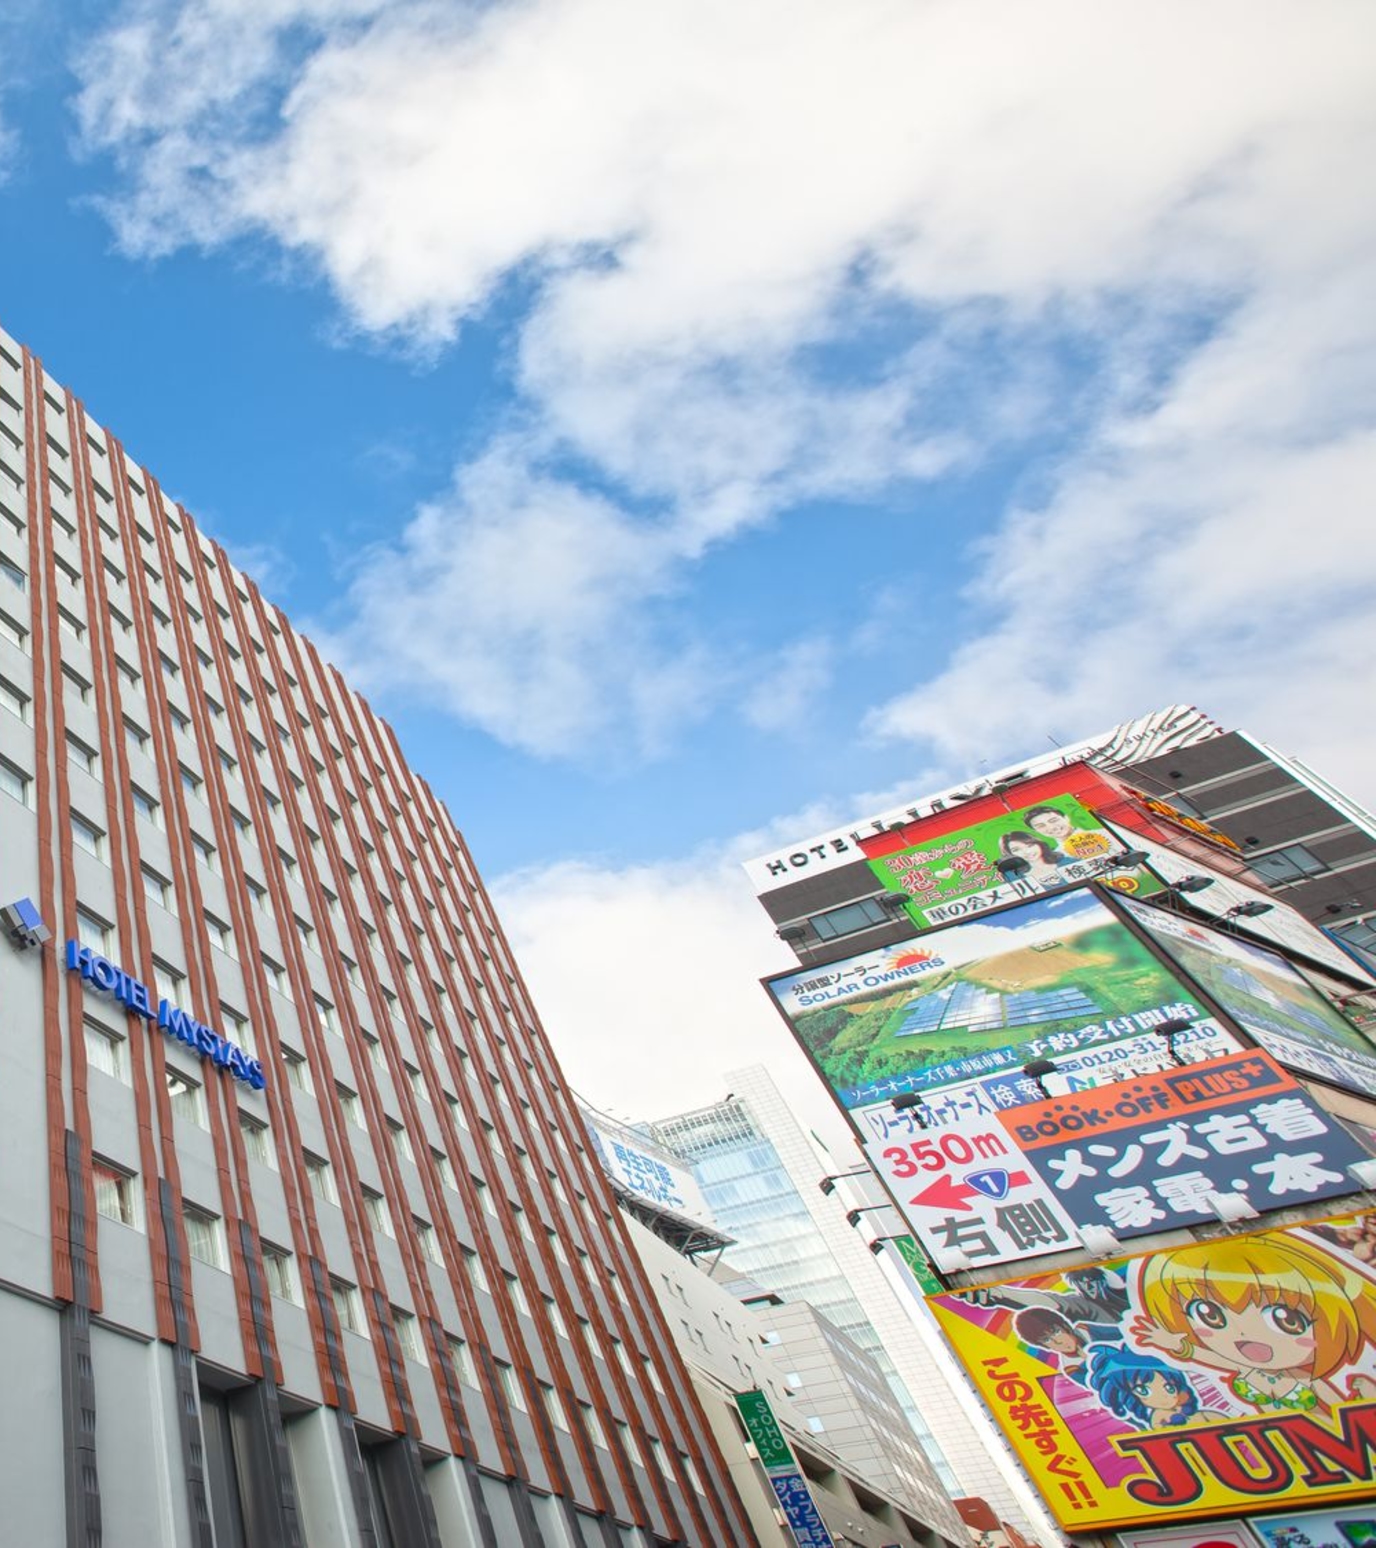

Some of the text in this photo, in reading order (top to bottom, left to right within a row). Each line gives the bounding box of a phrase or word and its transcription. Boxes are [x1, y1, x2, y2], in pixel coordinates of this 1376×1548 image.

[798, 957, 946, 1007] SOLAR OWNERS
[66, 939, 267, 1091] HOTEL MYSTAYS
[1024, 1001, 1200, 1058] 予約受付開始
[883, 1132, 1008, 1178] 350m
[1047, 1098, 1330, 1190] メンズ古着
[979, 1174, 1000, 1194] 1
[1094, 1152, 1346, 1227] 家電・本
[929, 1198, 1069, 1258] 右側
[748, 1417, 775, 1459] オフィス
[755, 1401, 784, 1450] SOHO
